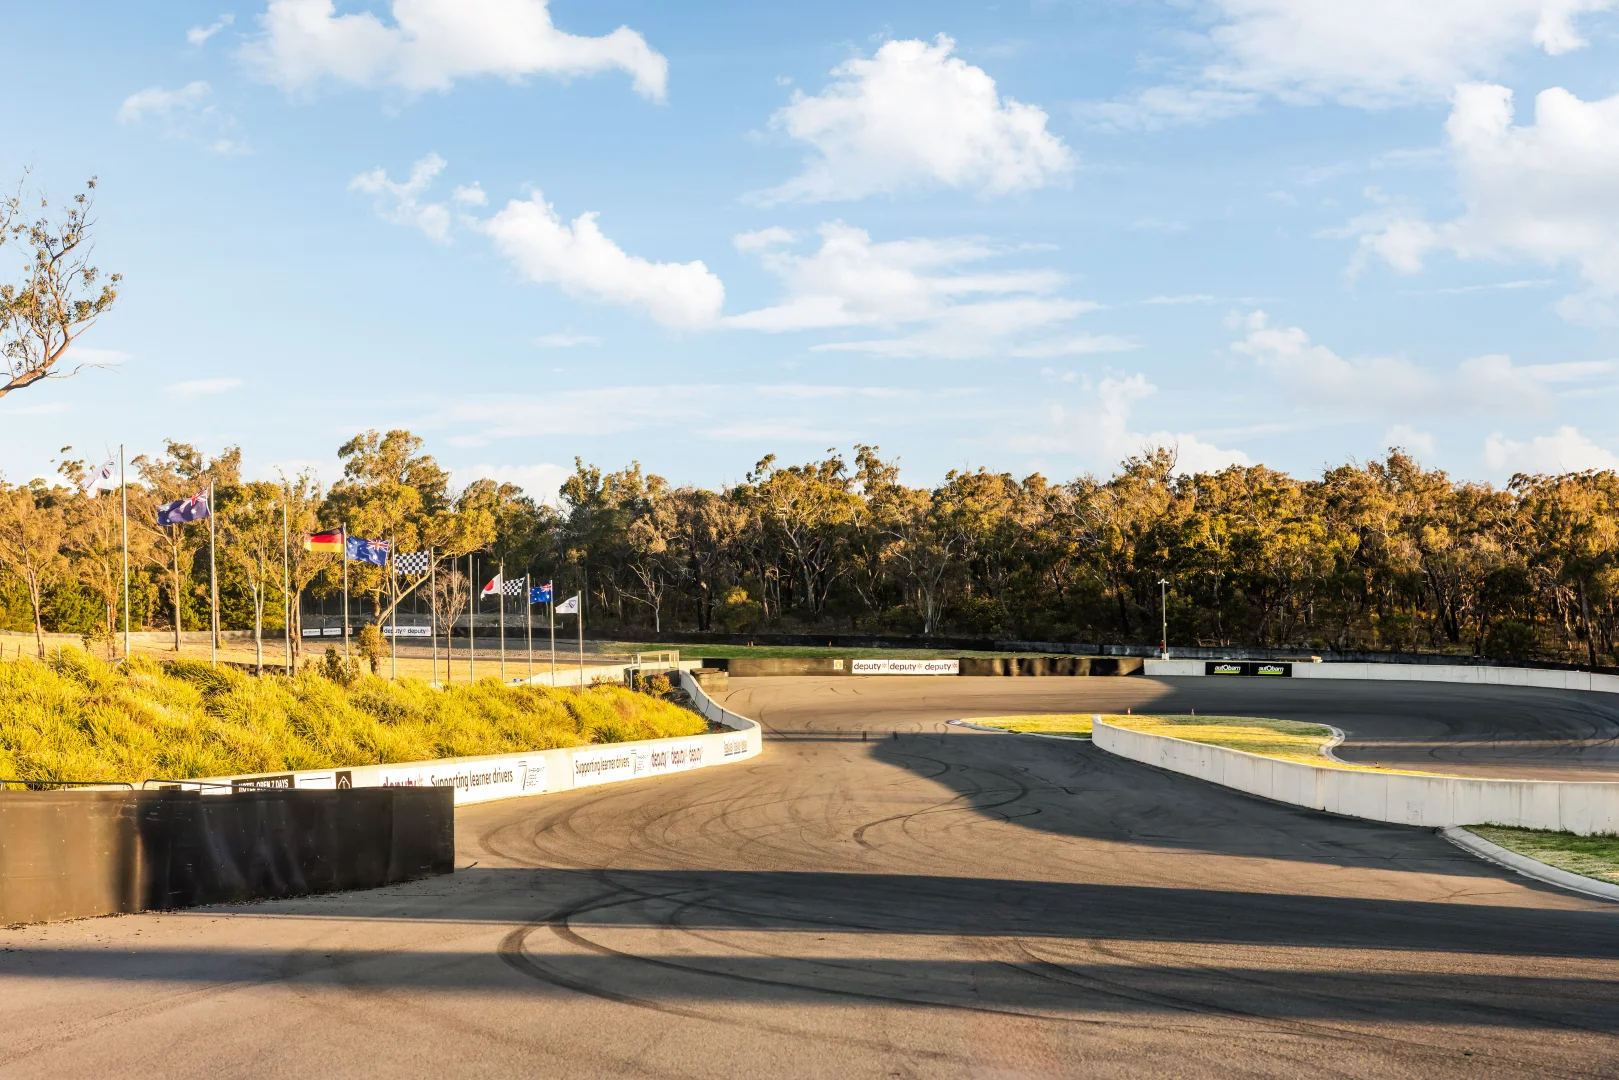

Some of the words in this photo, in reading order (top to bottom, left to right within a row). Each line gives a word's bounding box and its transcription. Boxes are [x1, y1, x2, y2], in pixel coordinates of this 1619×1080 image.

[853, 662, 881, 671] deputy
[890, 662, 917, 671] deputy
[924, 662, 951, 671] deputy
[575, 757, 600, 777] Supporting
[600, 756, 615, 771] learner
[616, 754, 630, 768] drivers
[651, 749, 666, 770] deputy
[671, 746, 685, 767] deputy
[689, 744, 701, 764] deputy
[256, 780, 271, 790] OPEN
[275, 778, 289, 788] DAYS
[470, 770, 491, 787] learner
[492, 766, 513, 784] drivers
